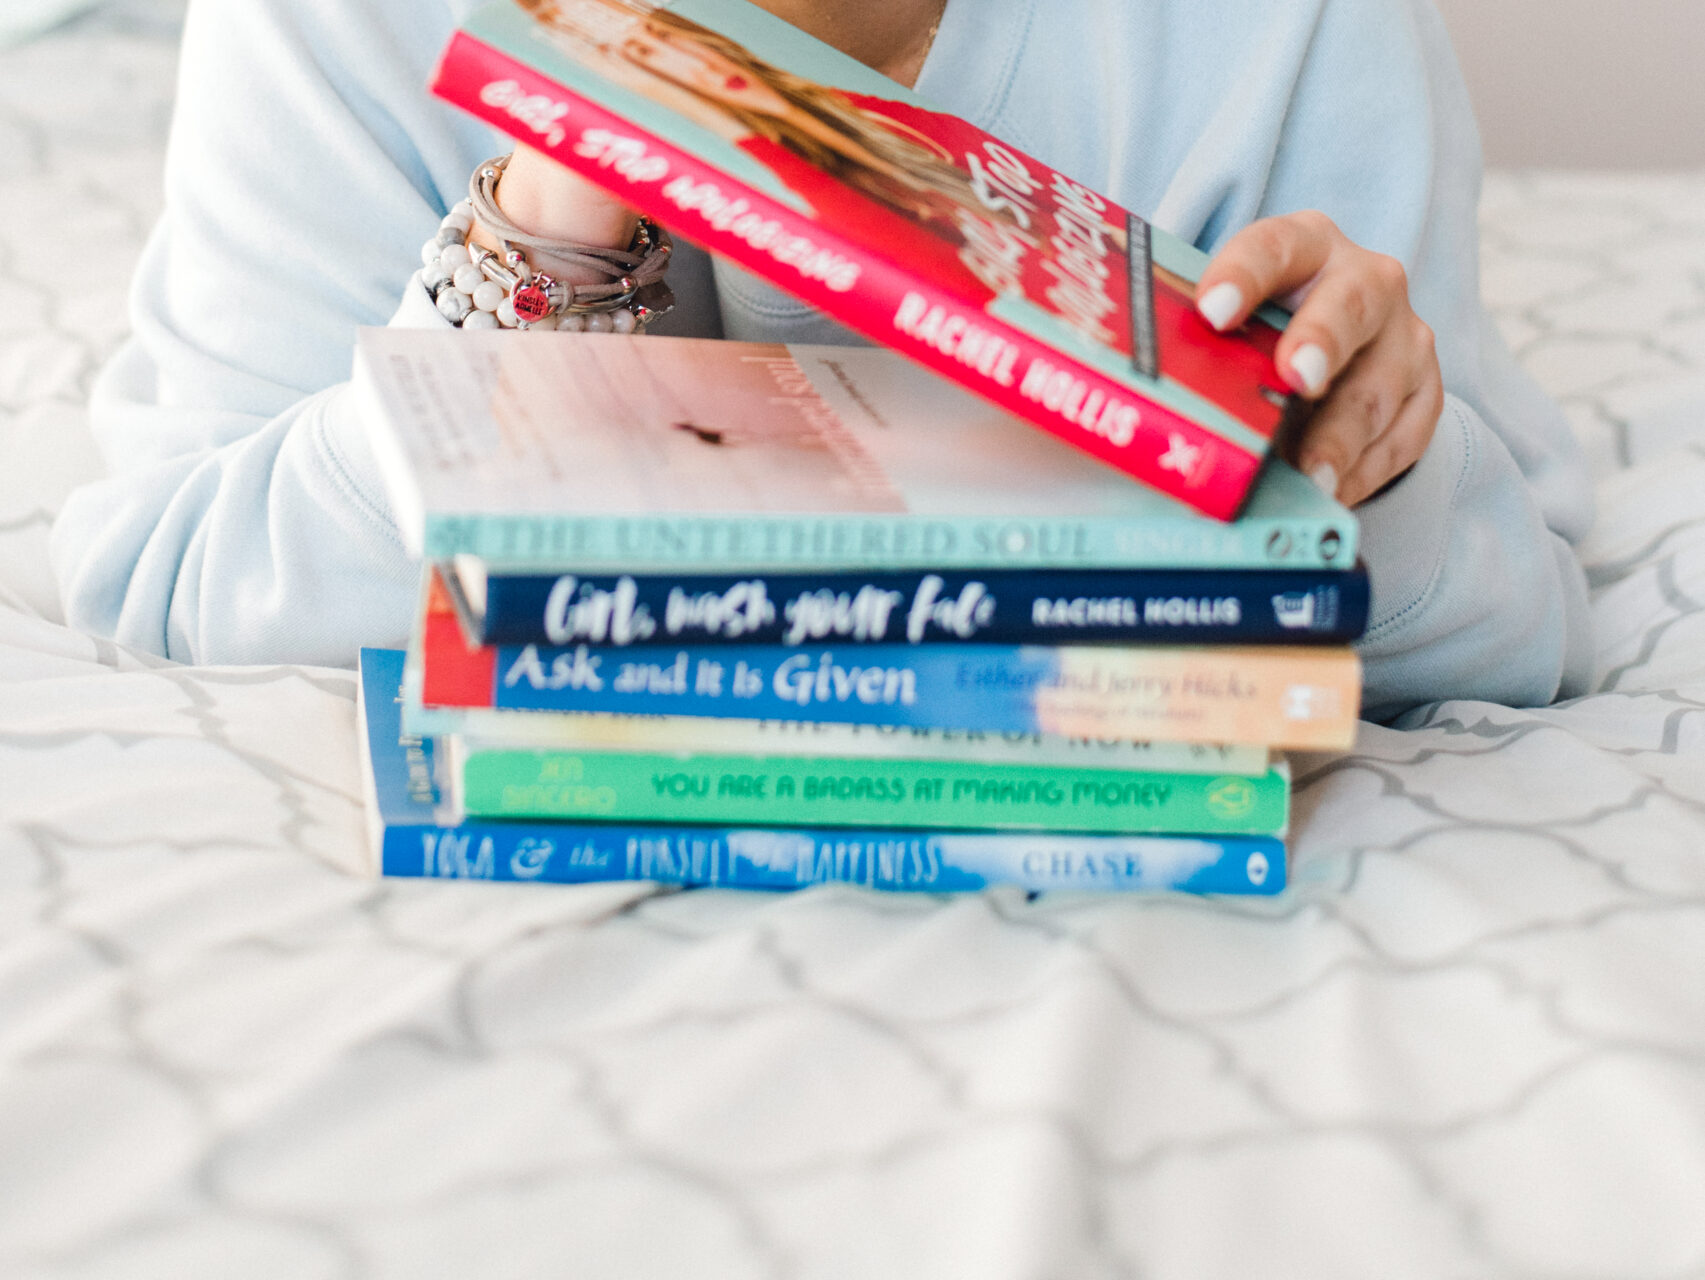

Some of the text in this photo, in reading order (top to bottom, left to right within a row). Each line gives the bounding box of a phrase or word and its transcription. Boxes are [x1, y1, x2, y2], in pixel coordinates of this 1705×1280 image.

[964, 141, 1044, 230] STOP
[573, 128, 669, 183] STOP
[661, 175, 862, 292] APOLOGIZING
[893, 291, 1019, 388] RACHEL
[1019, 358, 1140, 447] HOLLIS
[972, 520, 1094, 558] SOUL
[665, 579, 776, 638] wash
[782, 587, 905, 647] your
[907, 574, 997, 645] face
[1031, 596, 1138, 627] RACHEL
[1144, 596, 1242, 627] HOLLIS
[504, 644, 605, 692] Ask
[613, 651, 690, 696] and
[773, 651, 918, 706] Given
[651, 773, 1173, 808] YOU ARE A BADASS AT MAKING MONEY
[422, 832, 496, 880] YOGA
[509, 836, 555, 879] &
[569, 838, 613, 867] the
[1022, 851, 1143, 877] CHASE
